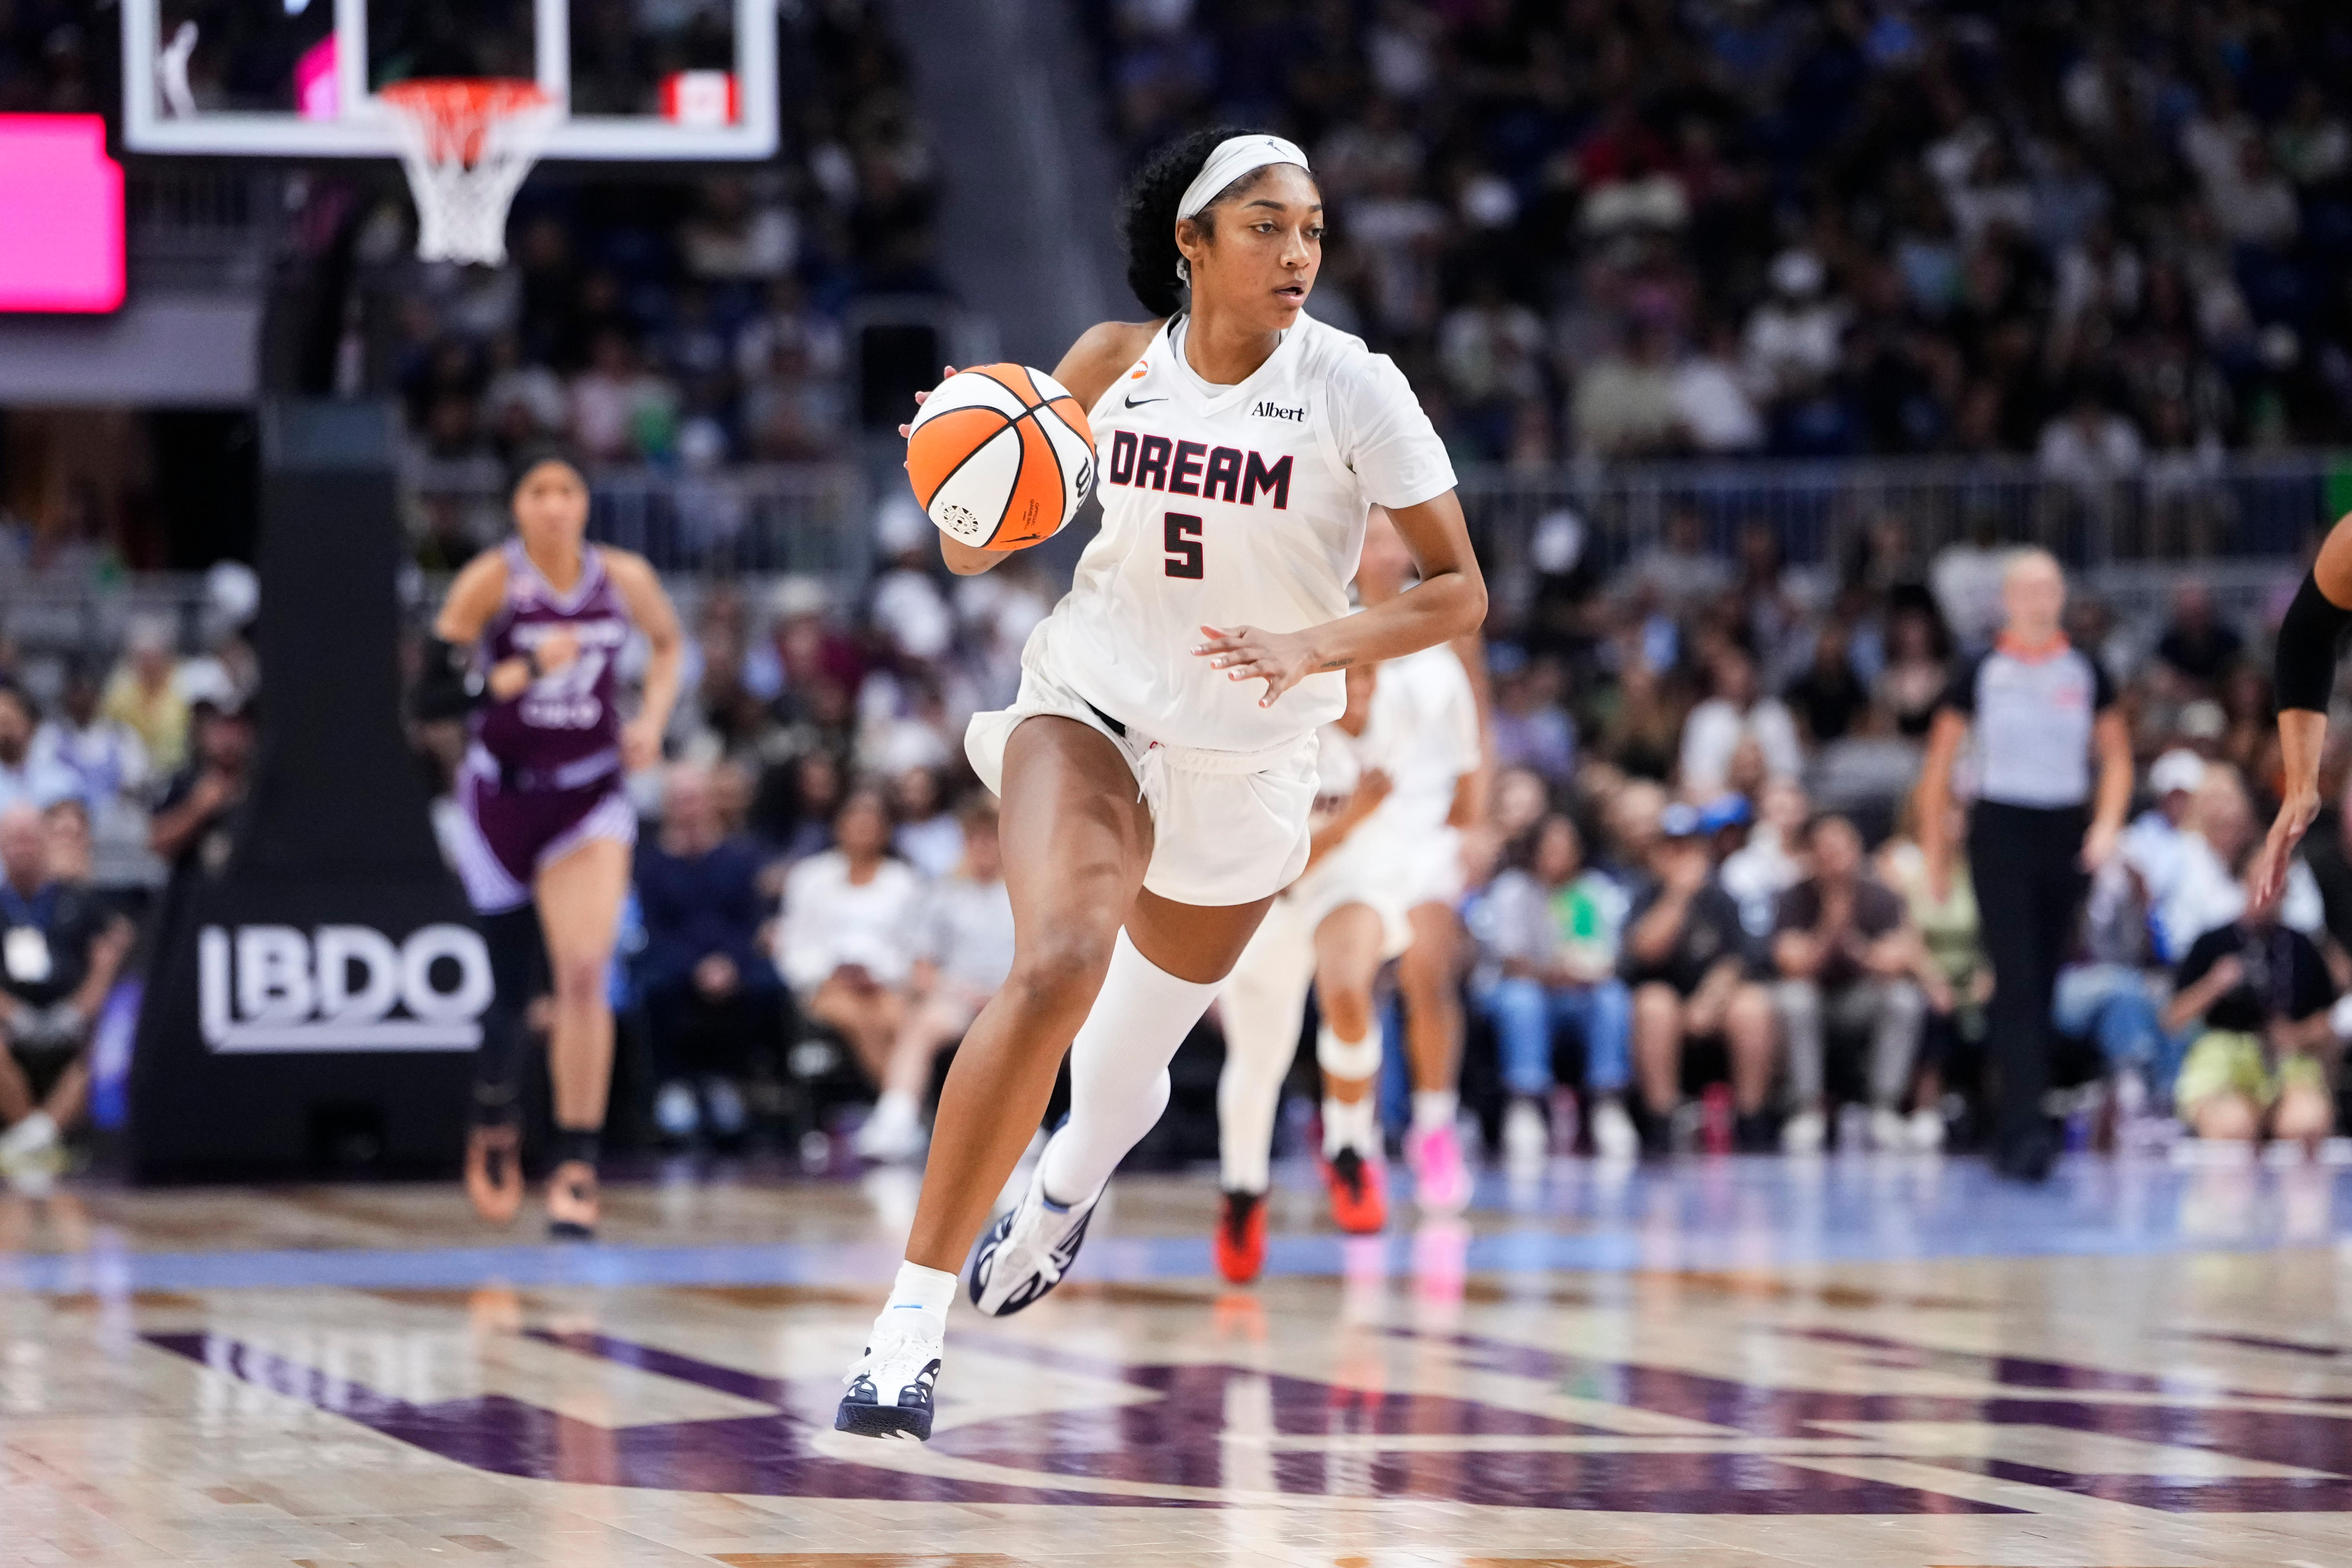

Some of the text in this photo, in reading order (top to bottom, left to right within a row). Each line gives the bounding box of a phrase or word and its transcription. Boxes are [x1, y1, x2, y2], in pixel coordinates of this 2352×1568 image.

[1251, 401, 1304, 422] Albert
[1110, 430, 1294, 510] DREAM
[1164, 512, 1203, 580] 5
[235, 923, 496, 1022] BDO
